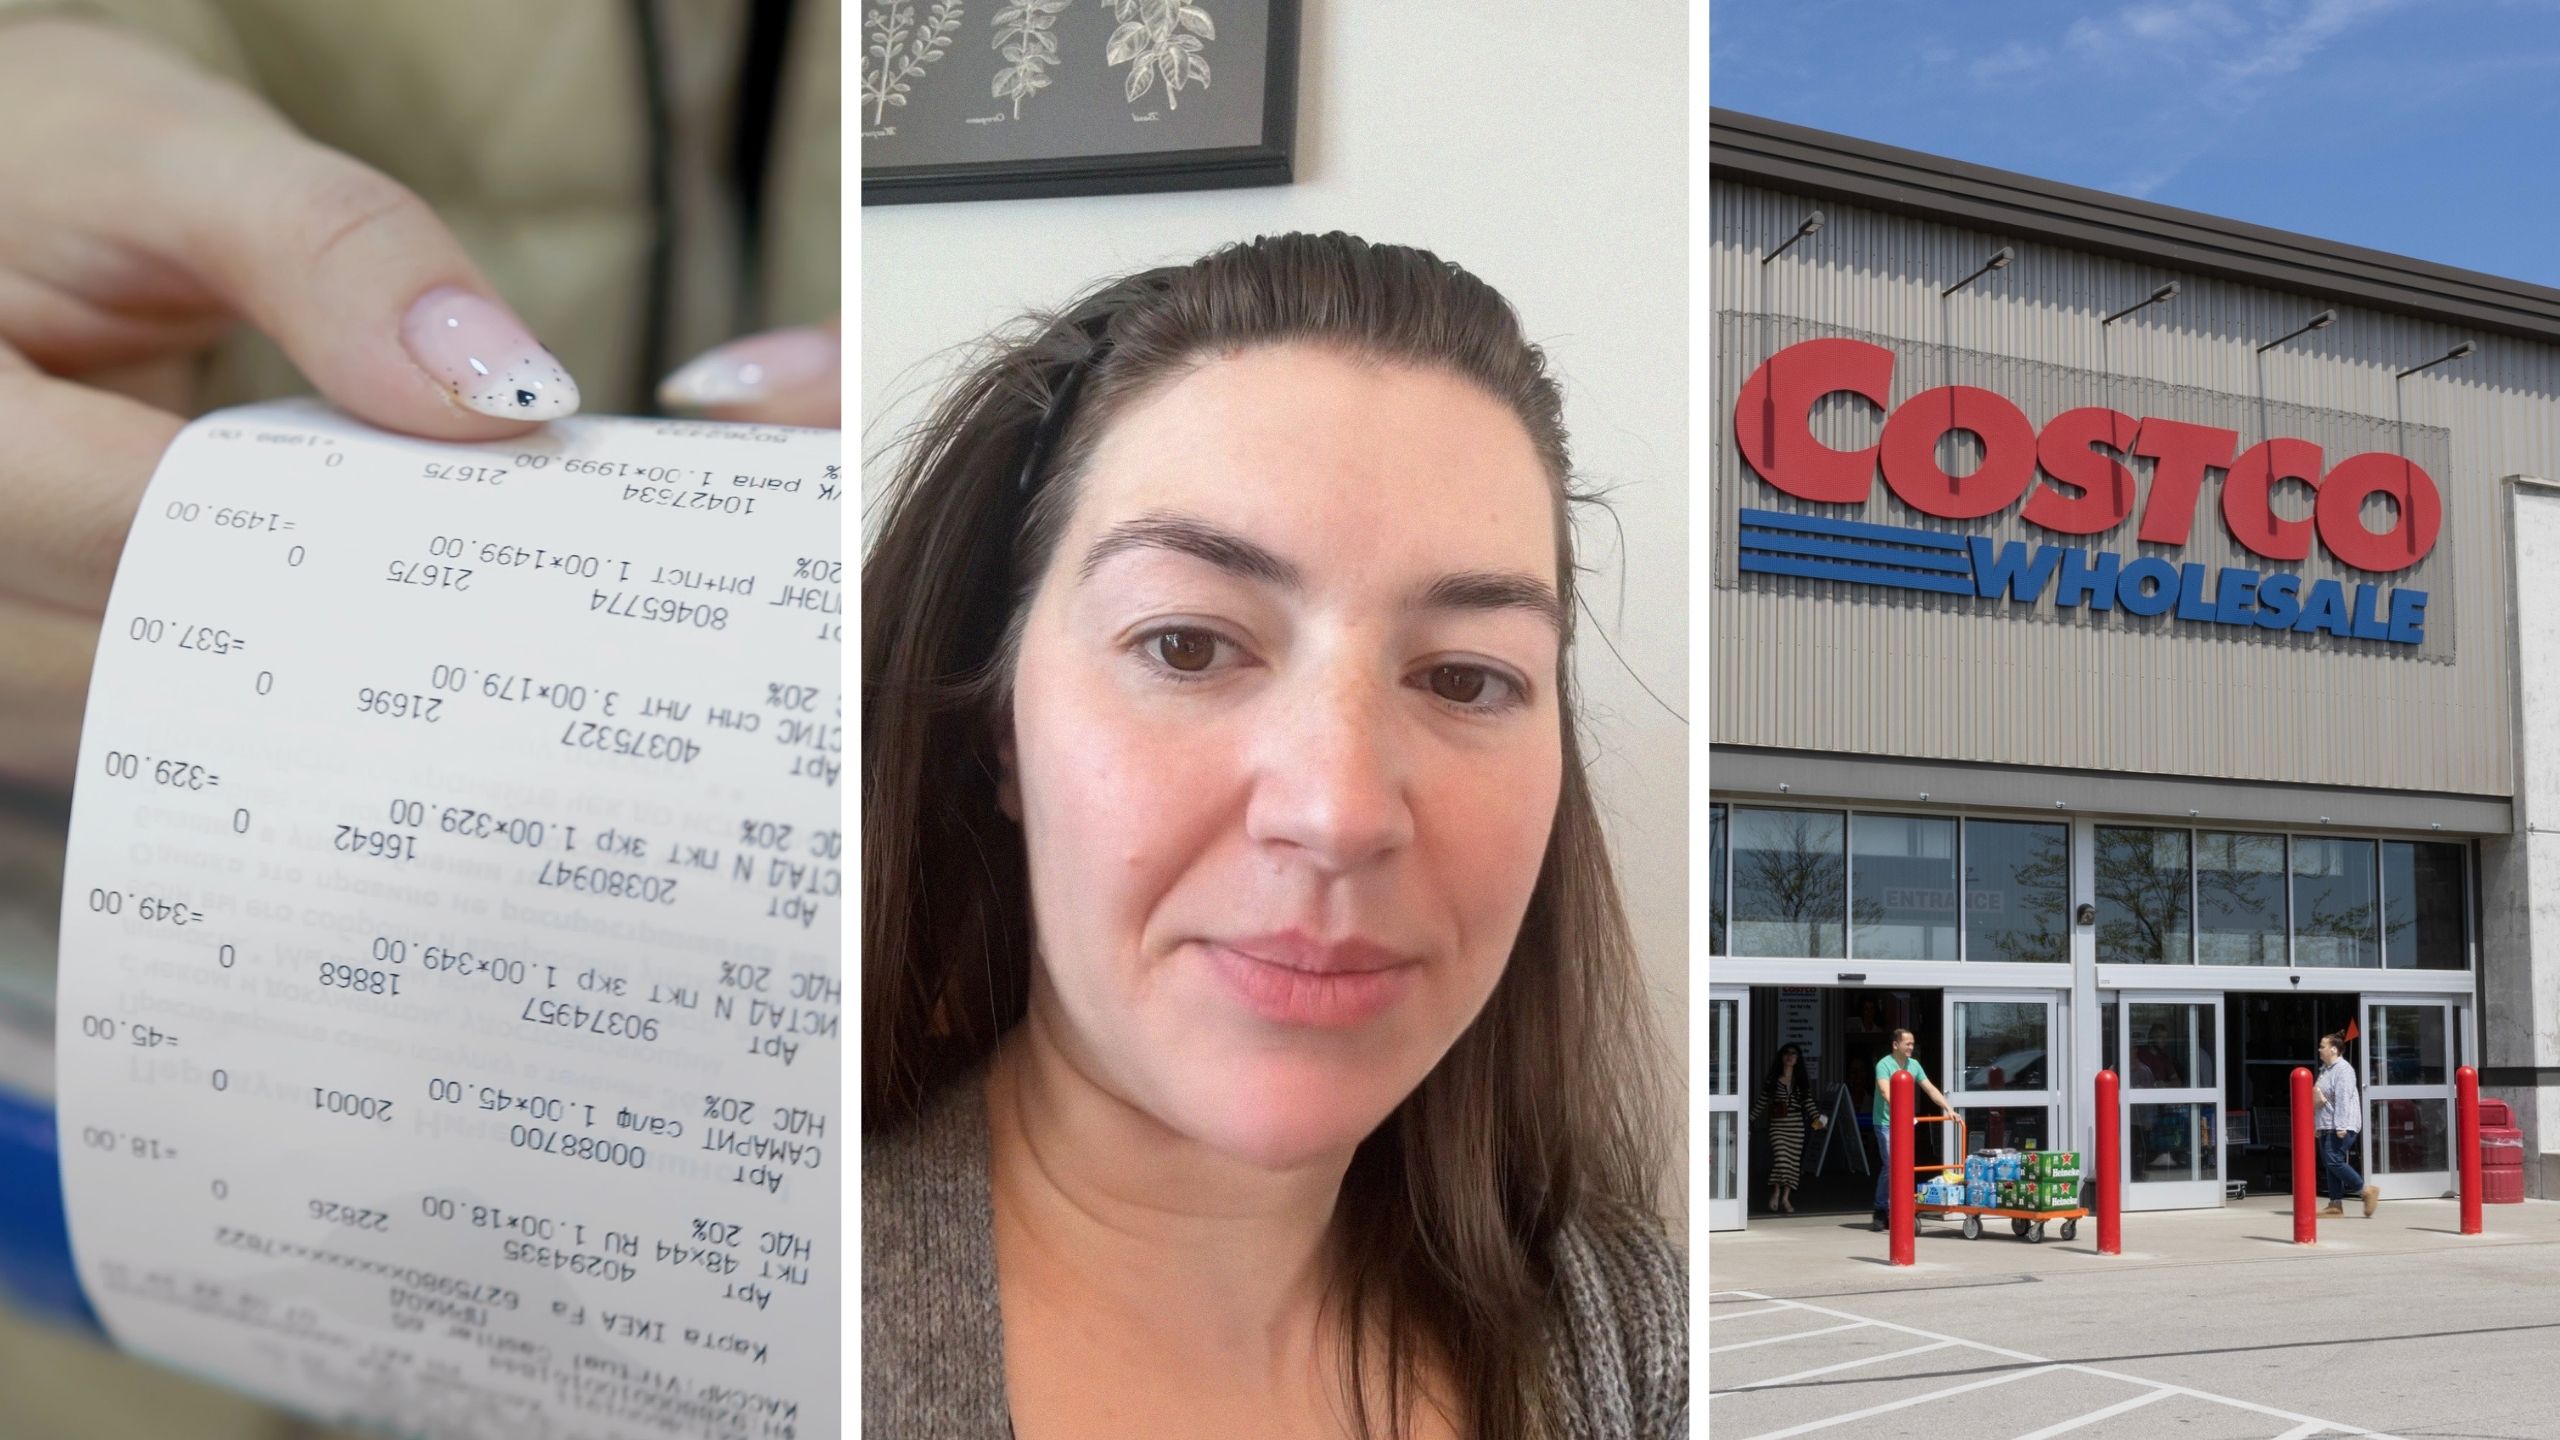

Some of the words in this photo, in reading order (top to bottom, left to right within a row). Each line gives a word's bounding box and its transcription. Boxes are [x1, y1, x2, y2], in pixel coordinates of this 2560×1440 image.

[1734, 337, 2442, 573] COSTCO
[423, 463, 509, 486] 21675
[165, 501, 296, 532] =1499.00
[287, 545, 306, 568] 0
[385, 559, 474, 592] 21675
[1967, 535, 2429, 646] WHOLESALE
[589, 588, 729, 631] 80465774
[129, 616, 246, 656] =537.00
[255, 670, 274, 697] 0
[356, 687, 444, 724] 21696
[560, 720, 702, 765] 40375327
[104, 750, 220, 791] =329.00
[789, 755, 842, 788] Арт
[232, 807, 251, 835] 0
[739, 818, 794, 852] 20%
[333, 823, 417, 862] 16642
[666, 844, 719, 871] пкт
[537, 859, 678, 905] 20380947
[89, 887, 204, 926] =349.00
[766, 896, 819, 929] Арт
[1886, 890, 2001, 911] ENTRANCE
[218, 943, 236, 969] 0
[318, 961, 401, 997] 18868
[718, 960, 772, 993] 20%
[647, 983, 699, 1010] пкт
[82, 1014, 179, 1048] =45.00
[521, 996, 660, 1042] 90374957
[749, 998, 839, 1039] ИСТАД
[747, 1034, 800, 1067] Арт
[211, 1068, 229, 1092] 0
[312, 1087, 394, 1123] 20001
[703, 1094, 756, 1126] 20%
[616, 1106, 684, 1139] салф
[772, 1106, 826, 1139] НДС
[83, 1127, 177, 1160] =18.00
[509, 1124, 647, 1170] 00088700
[701, 1127, 822, 1169] САМАРИТ
[732, 1164, 784, 1195] Арт
[308, 1199, 389, 1233] 22826
[604, 1231, 640, 1258] RU
[691, 1217, 744, 1249] 20%
[759, 1231, 812, 1262] НДС
[758, 1260, 809, 1286] пкт
[551, 1300, 585, 1326] Fa
[722, 1282, 772, 1311] Арт
[601, 1311, 665, 1343] IKEA
[683, 1328, 768, 1365] Карта
